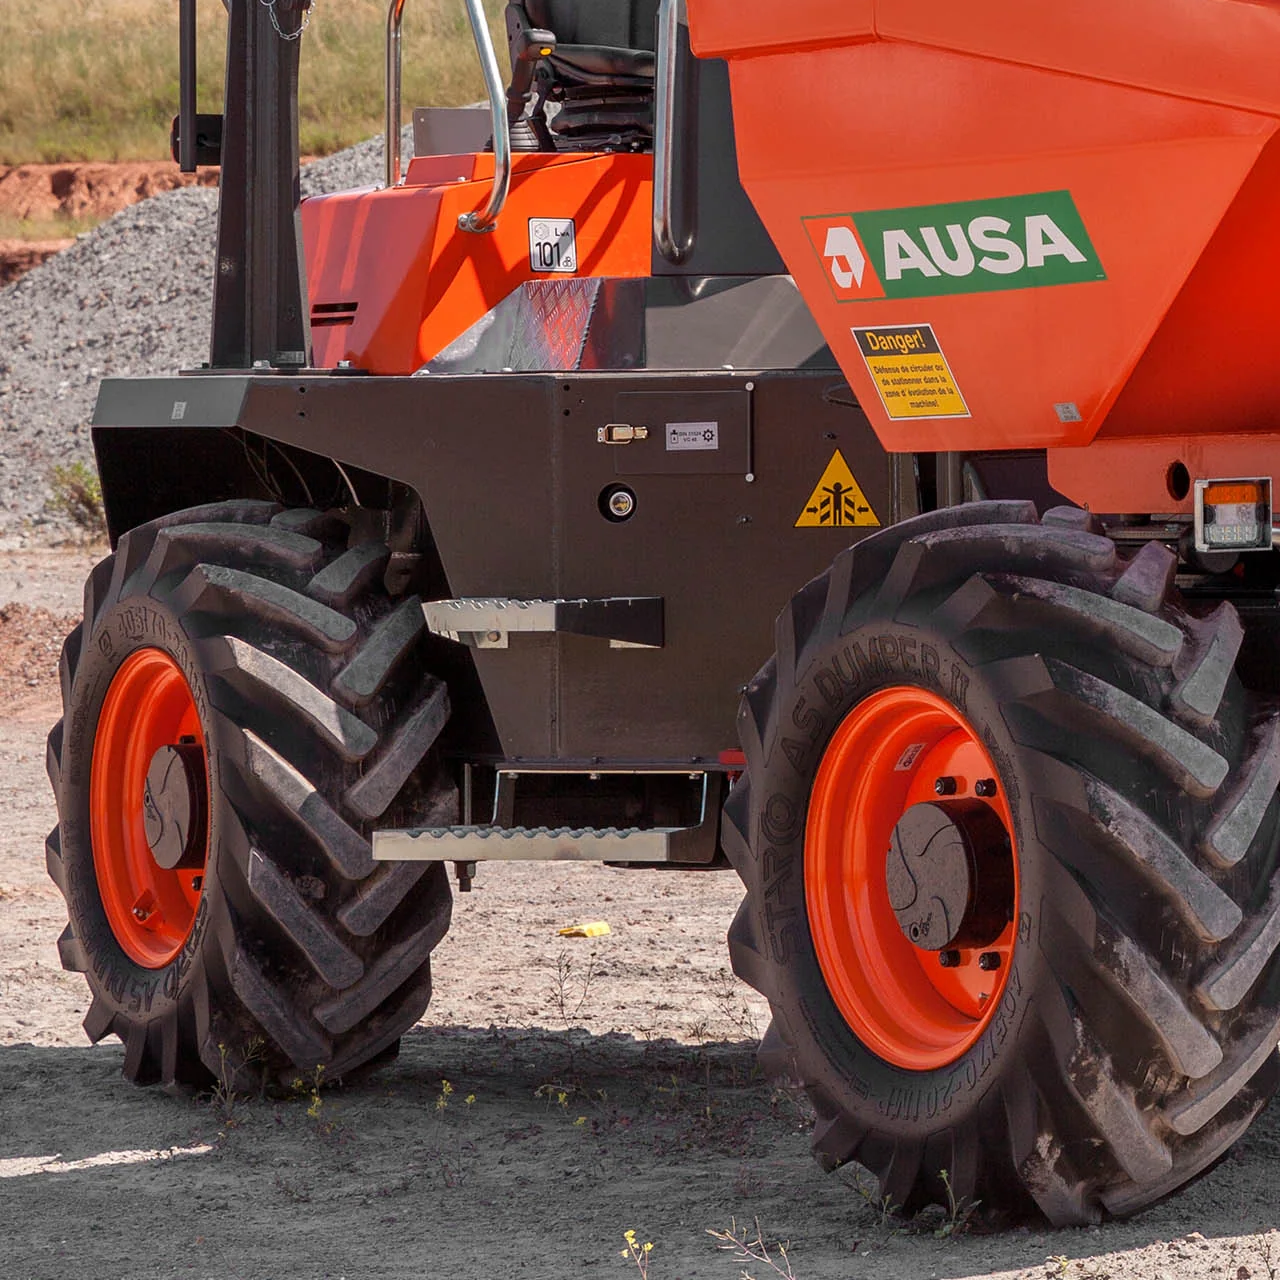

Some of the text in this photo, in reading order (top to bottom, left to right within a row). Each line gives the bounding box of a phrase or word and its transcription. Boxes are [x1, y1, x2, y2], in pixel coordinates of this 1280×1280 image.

[535, 241, 561, 267] 101
[883, 214, 1087, 280] AUSA
[865, 329, 926, 354] Danger!
[781, 696, 823, 770] AS
[814, 635, 941, 710] DUMPER
